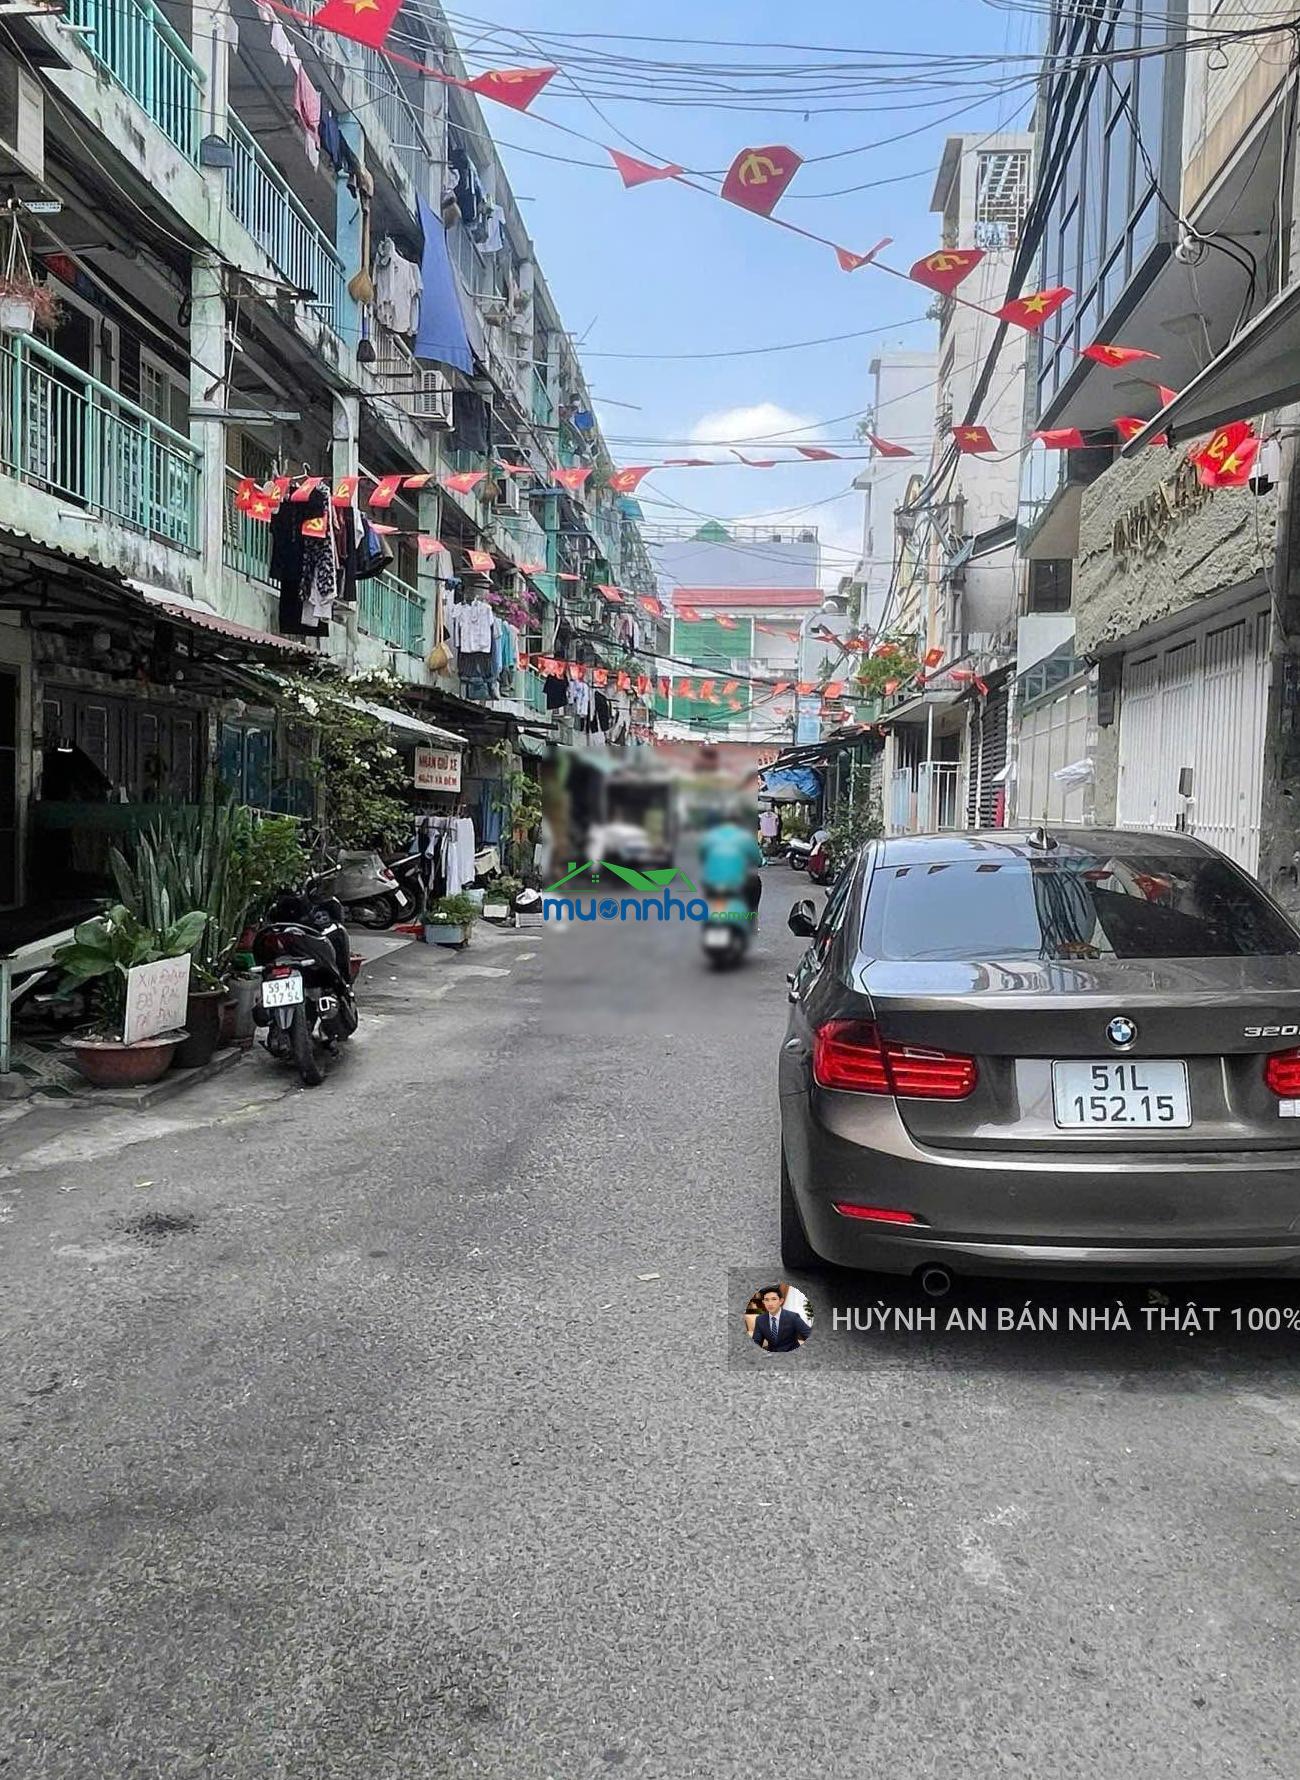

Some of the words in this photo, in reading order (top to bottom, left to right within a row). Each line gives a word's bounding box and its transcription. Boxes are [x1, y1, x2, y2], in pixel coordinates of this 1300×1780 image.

[1243, 1024, 1300, 1037] 320
[1091, 1064, 1149, 1091] 51L
[1074, 1095, 1175, 1122] 152.15
